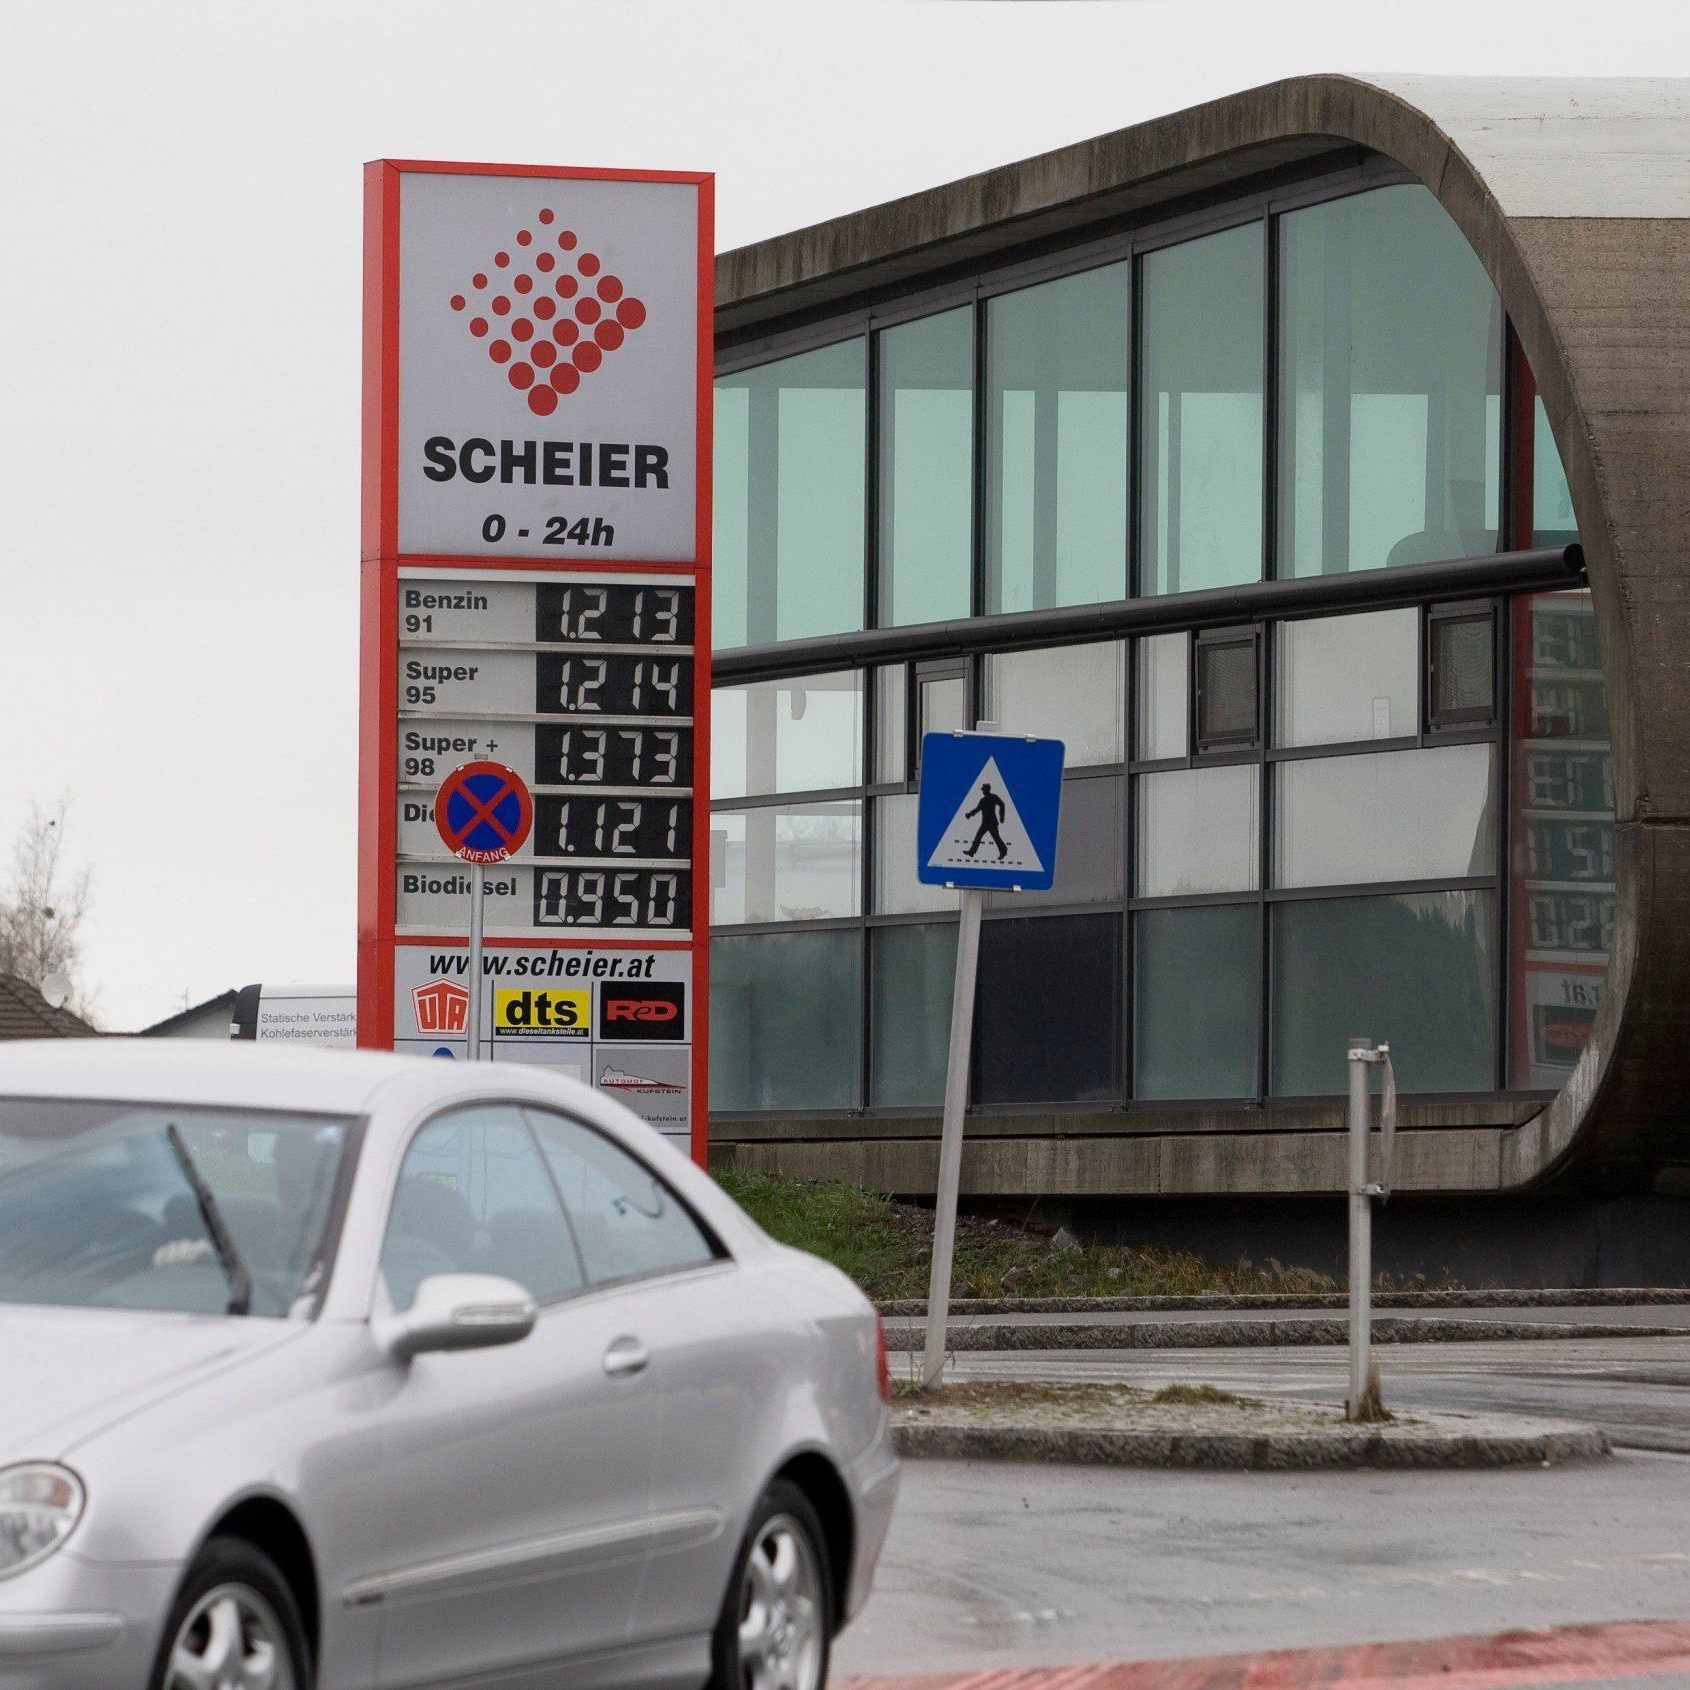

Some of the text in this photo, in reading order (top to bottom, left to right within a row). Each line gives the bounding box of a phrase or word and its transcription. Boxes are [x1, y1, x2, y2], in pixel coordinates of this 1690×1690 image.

[423, 436, 669, 489] SCHEIER
[482, 514, 506, 543] 0
[543, 516, 615, 547] 24h
[405, 590, 488, 610] Benzin
[405, 615, 433, 633] 91
[560, 588, 679, 641] 1.213
[406, 661, 478, 684] Super
[559, 659, 678, 711] 1.214
[406, 686, 436, 704] 95
[405, 732, 499, 755] Super +
[559, 730, 677, 783] 1.373
[405, 757, 435, 776] 98
[558, 802, 678, 853] 1.121
[459, 847, 508, 862] ANFANG
[538, 872, 677, 925] 0.950
[261, 1013, 309, 1023] Statische
[417, 982, 469, 1030] UTA
[506, 991, 578, 1027] dts
[499, 1028, 584, 1037] www.dieseltankstelle.at
